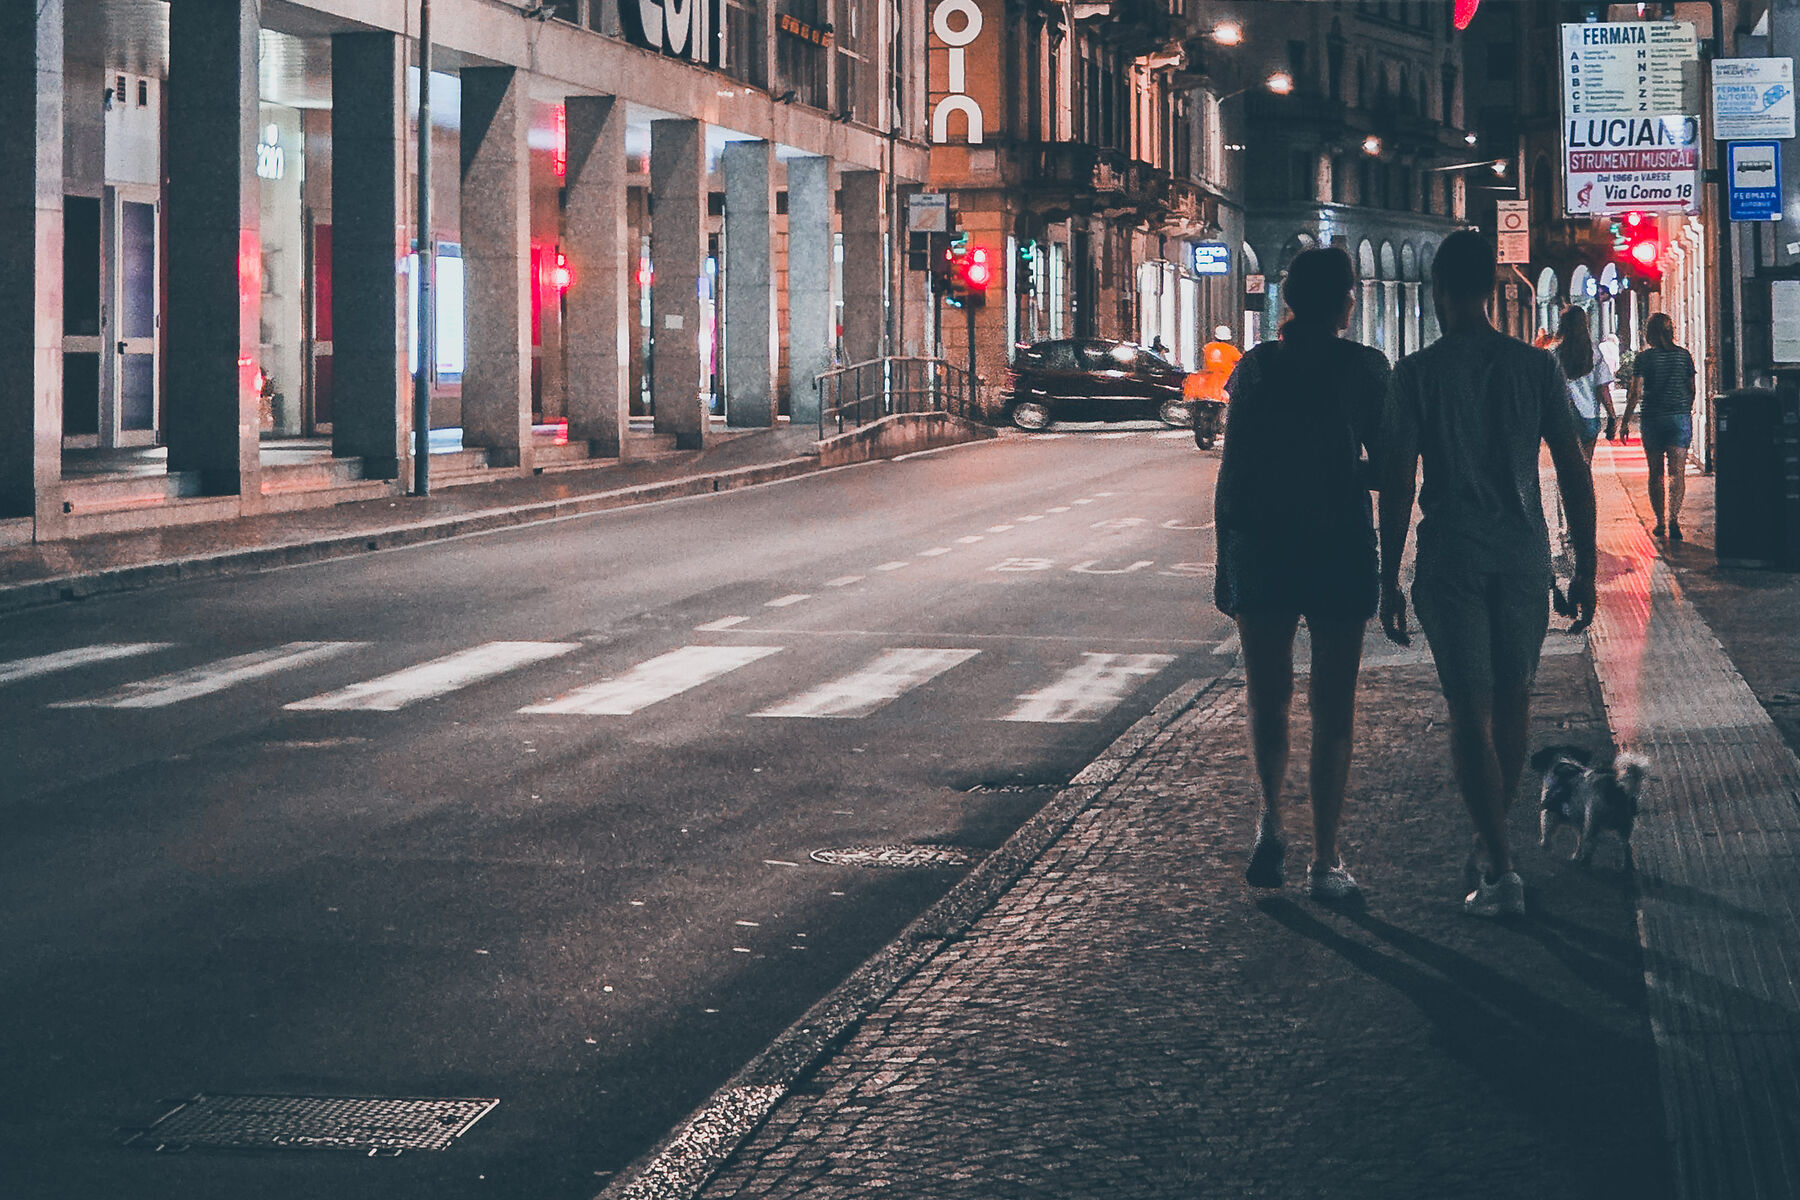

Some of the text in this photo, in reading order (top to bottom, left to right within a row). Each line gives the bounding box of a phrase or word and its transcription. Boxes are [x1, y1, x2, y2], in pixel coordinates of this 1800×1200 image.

[1583, 26, 1647, 45] FERMATA
[1570, 51, 1579, 60] A
[1637, 49, 1646, 59] H
[1571, 64, 1580, 74] B
[1638, 63, 1647, 72] N
[1572, 78, 1581, 87] B
[1639, 76, 1647, 85] P
[1572, 91, 1581, 100] C
[1639, 89, 1647, 98] Z
[1573, 104, 1581, 114] E
[1639, 102, 1648, 111] Z
[1569, 116, 1698, 148] LUCIANO
[257, 123, 284, 179] oin
[1571, 150, 1639, 170] STRUMENTI
[1597, 173, 1610, 183] Dal
[1613, 173, 1633, 183] 1966
[1641, 172, 1671, 182] VARESE
[1604, 183, 1693, 200] Via Como 18
[1734, 192, 1777, 200] FERMATA
